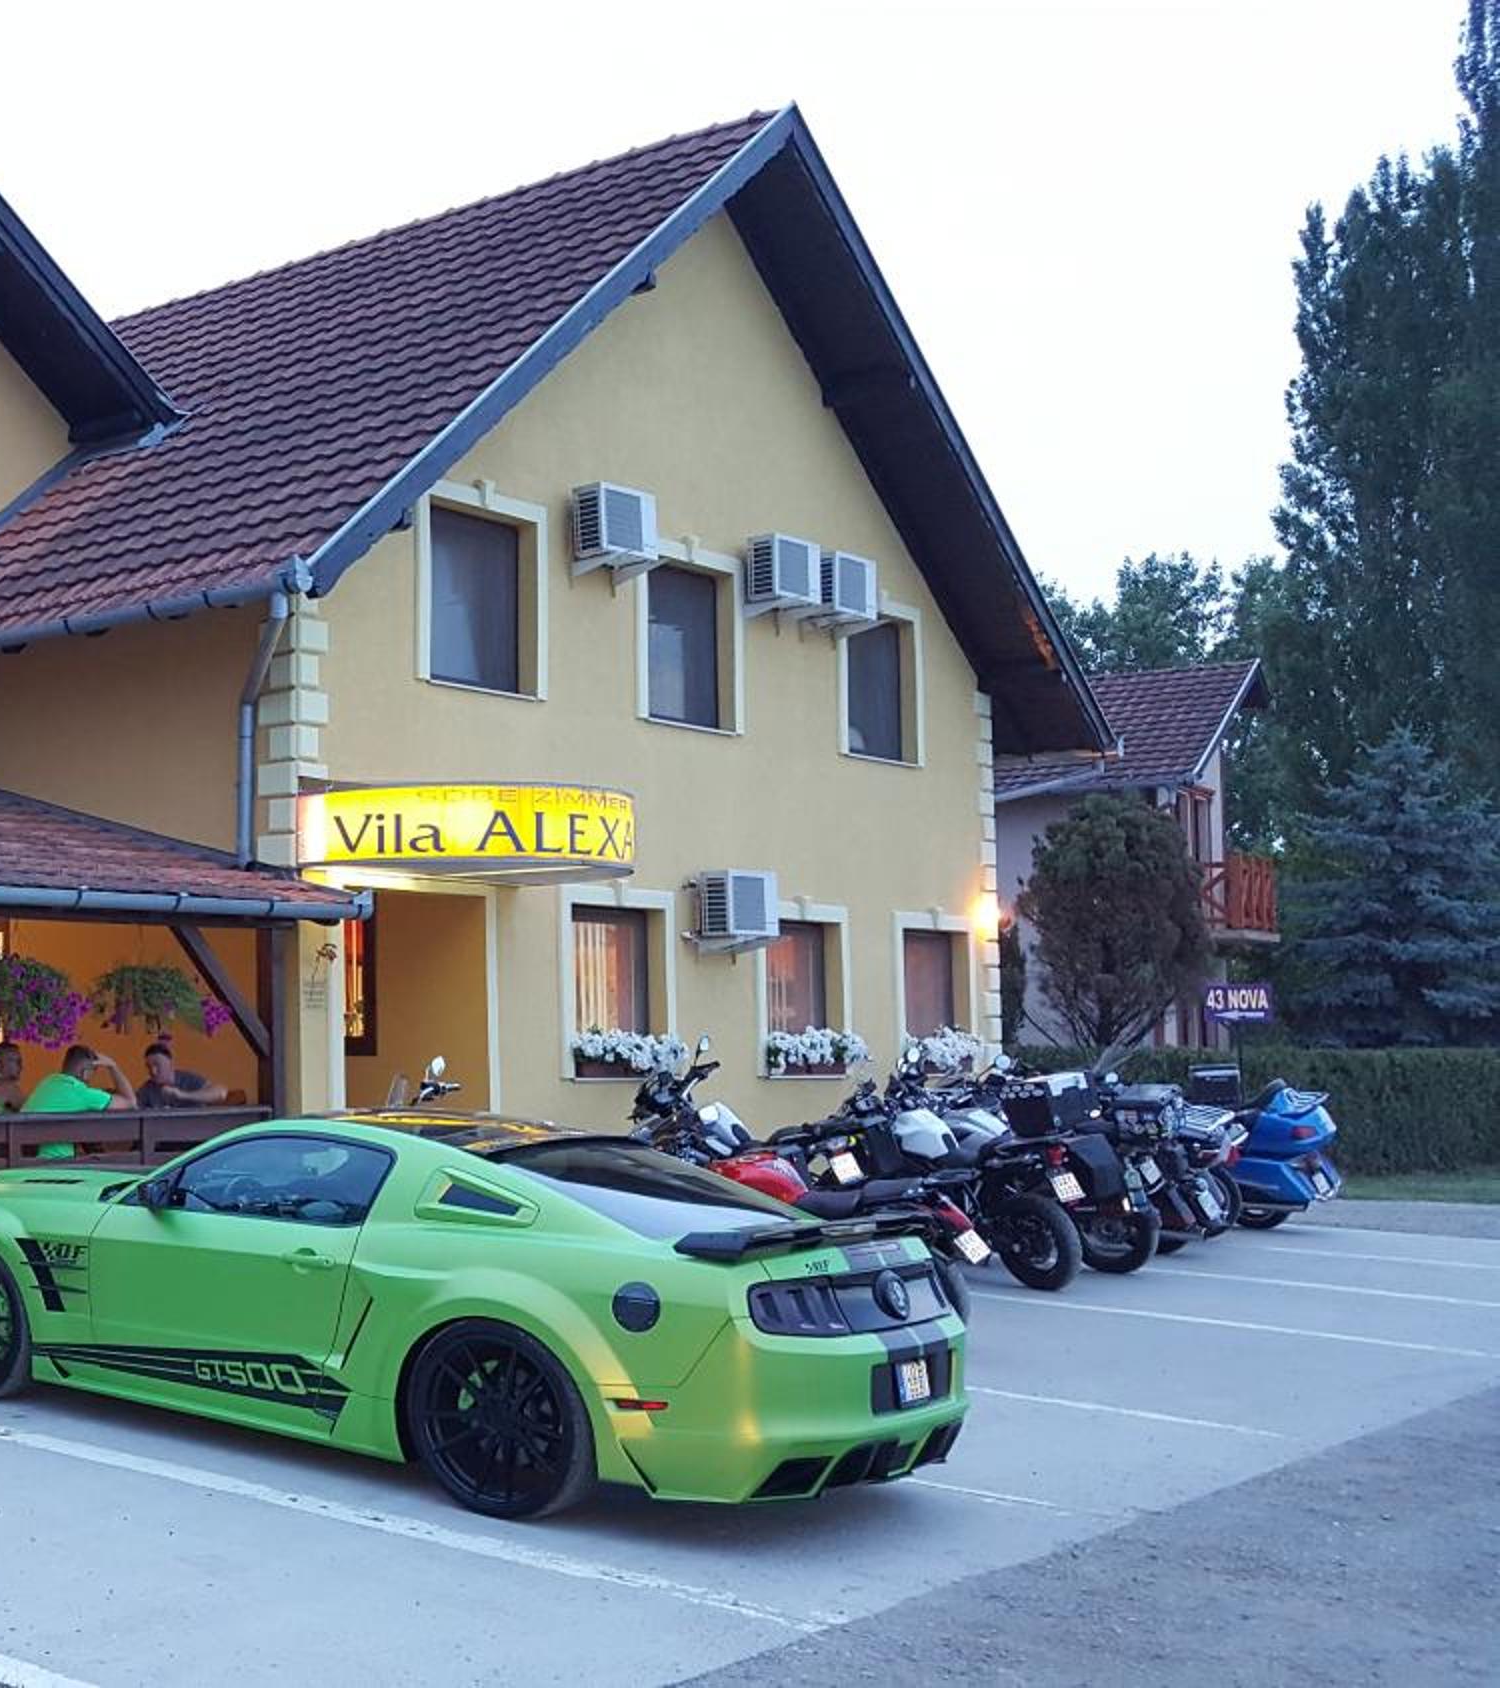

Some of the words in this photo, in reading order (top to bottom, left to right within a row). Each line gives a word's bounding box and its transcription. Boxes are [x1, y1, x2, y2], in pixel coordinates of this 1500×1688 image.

[534, 787, 628, 810] ZIMMER
[334, 813, 446, 854] Vila
[1206, 988, 1224, 1010] 43
[1227, 988, 1269, 1009] NOVA
[194, 1358, 308, 1395] GT500
